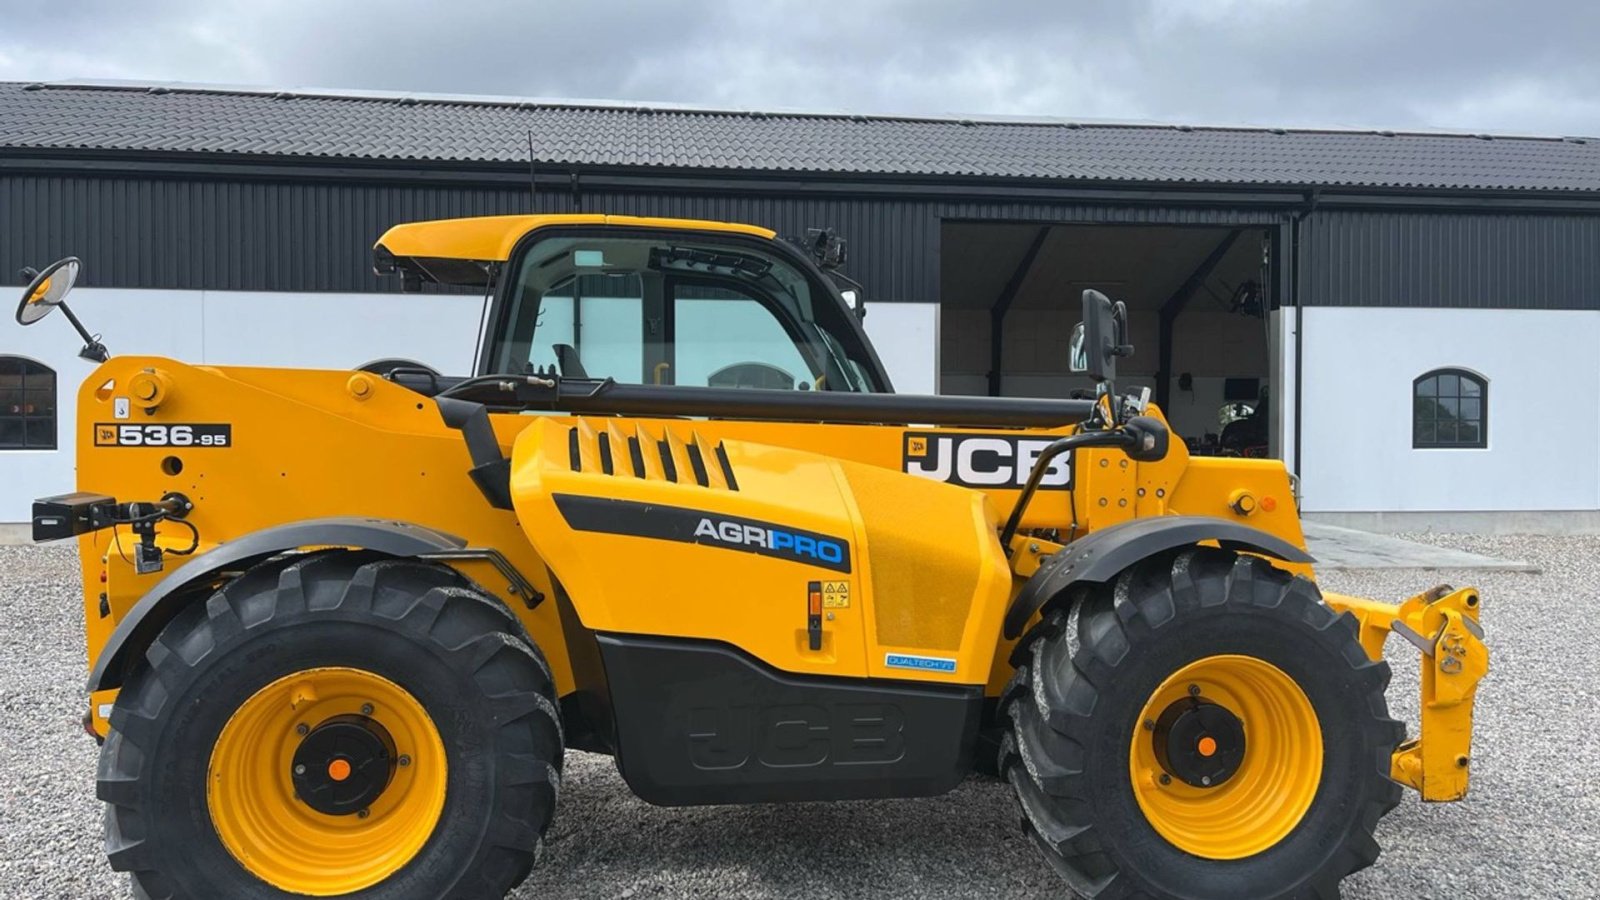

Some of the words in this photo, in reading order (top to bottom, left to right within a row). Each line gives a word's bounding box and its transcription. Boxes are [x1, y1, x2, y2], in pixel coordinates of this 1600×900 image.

[907, 437, 1070, 486] JCB
[694, 518, 843, 563] AGRIPRO
[688, 702, 906, 771] JCB
